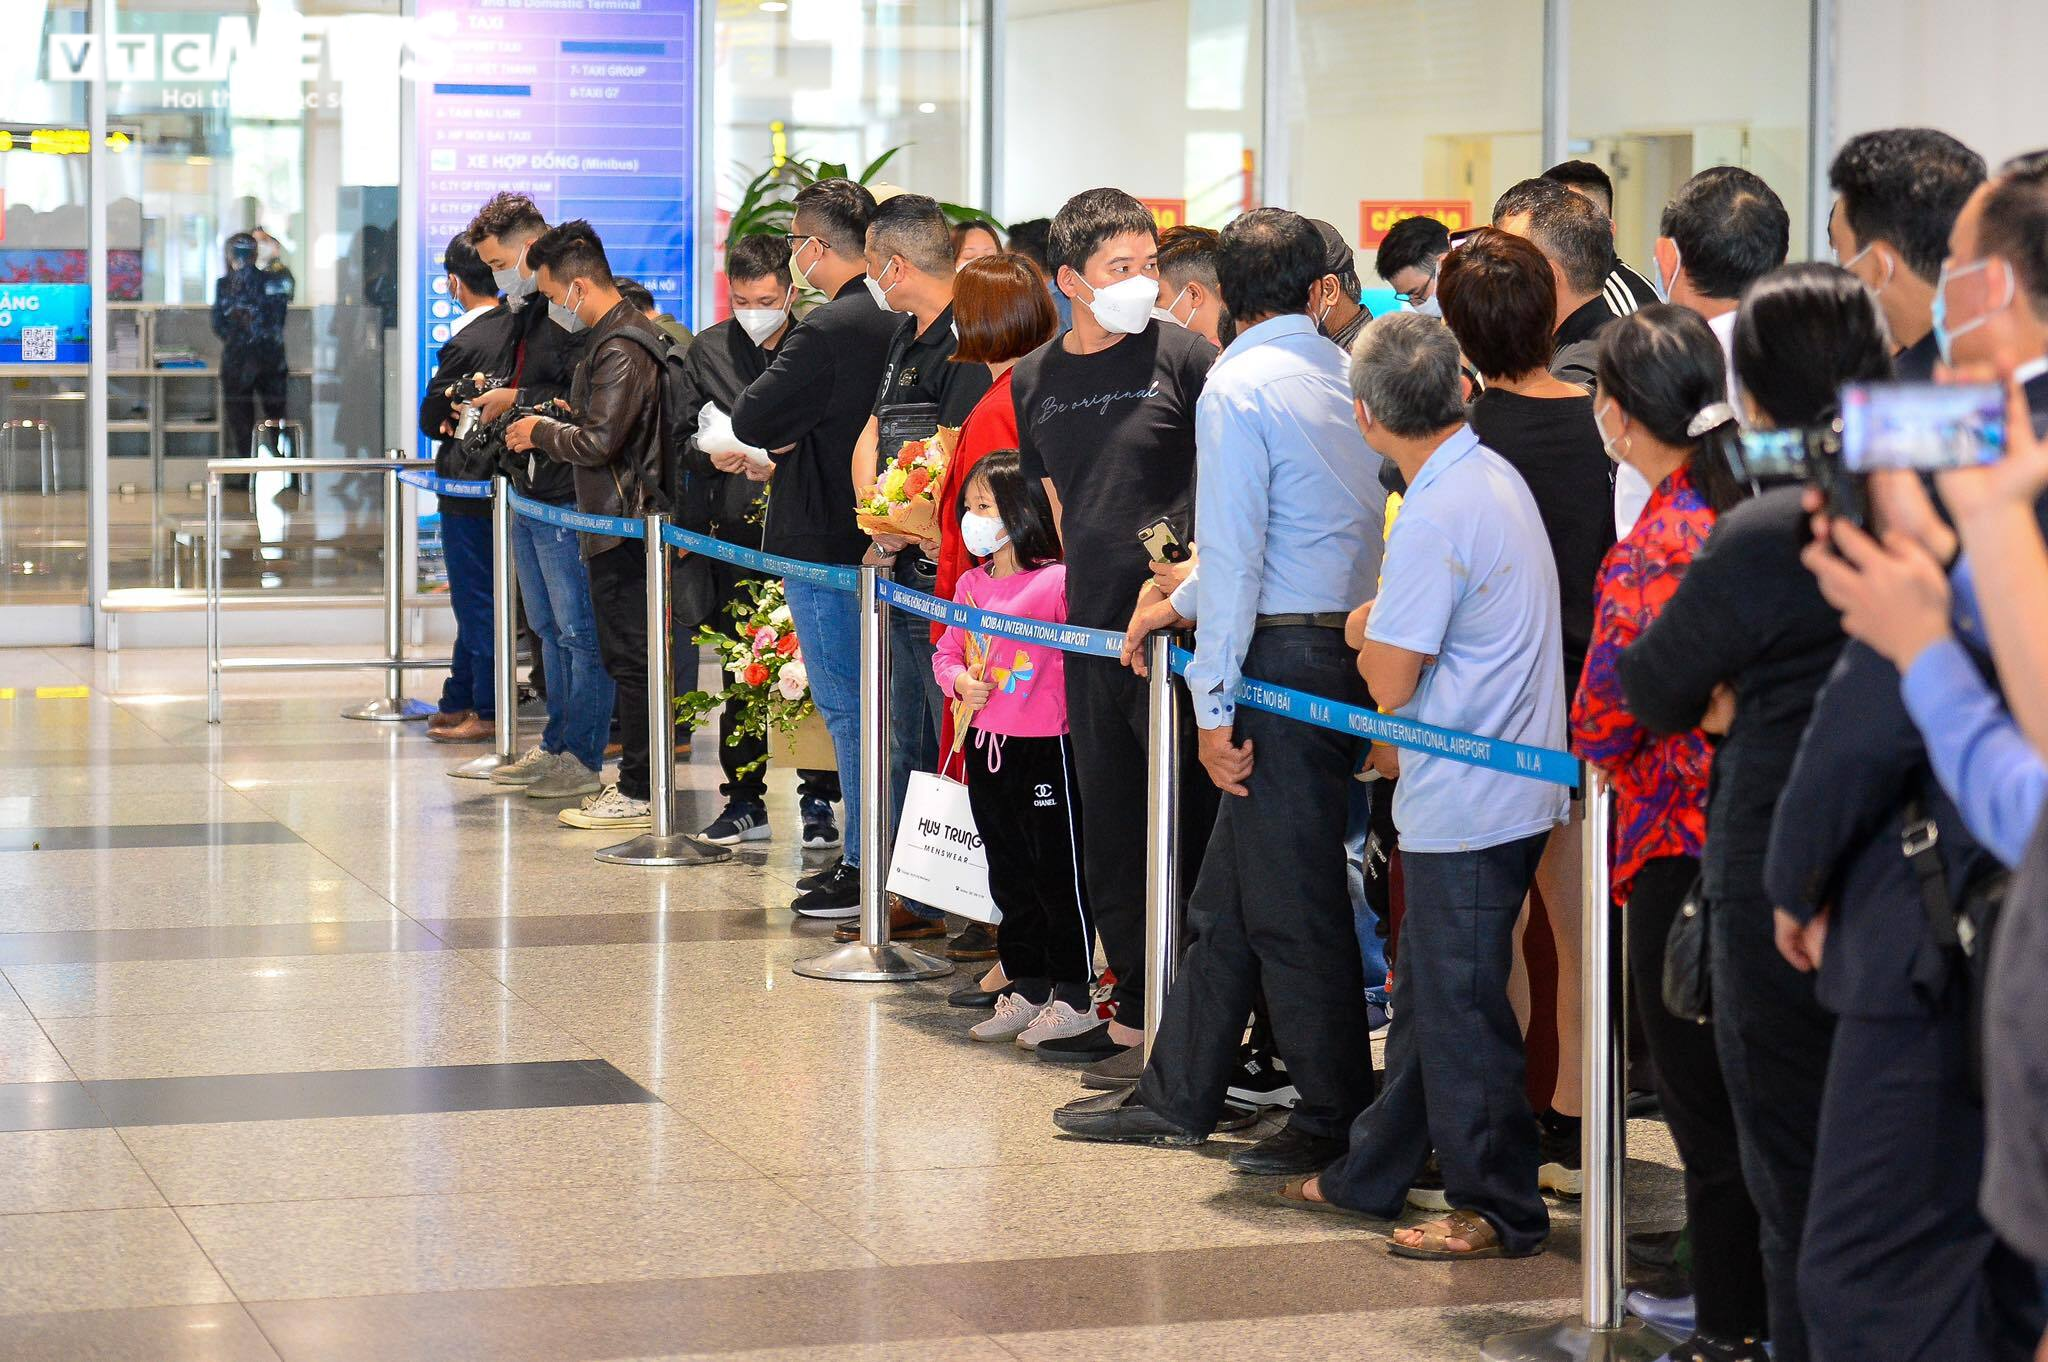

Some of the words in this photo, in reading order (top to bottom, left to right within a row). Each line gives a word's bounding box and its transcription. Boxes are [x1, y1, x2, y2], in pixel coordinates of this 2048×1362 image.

[467, 16, 504, 30] TAXI
[467, 155, 489, 169] XE
[581, 159, 640, 172] (Minibus)
[1038, 396, 1069, 424] Be
[1071, 380, 1160, 415] original
[953, 608, 968, 623] N.I.A
[980, 614, 1004, 631] NOIBAI
[1003, 621, 1058, 642] INTERNATIONAL
[1058, 631, 1091, 647] AIRPORT
[1105, 637, 1123, 652] N.I.A
[1310, 701, 1331, 722] N.I.A
[1377, 719, 1450, 752] INTERNATIONAL
[1449, 736, 1491, 761] AIRPORT
[1515, 751, 1541, 773] N.I.A
[1033, 798, 1057, 807] CHANEL
[917, 816, 941, 837] HUY
[944, 824, 982, 851] TRUNG
[923, 844, 969, 864] MENSWEAR
